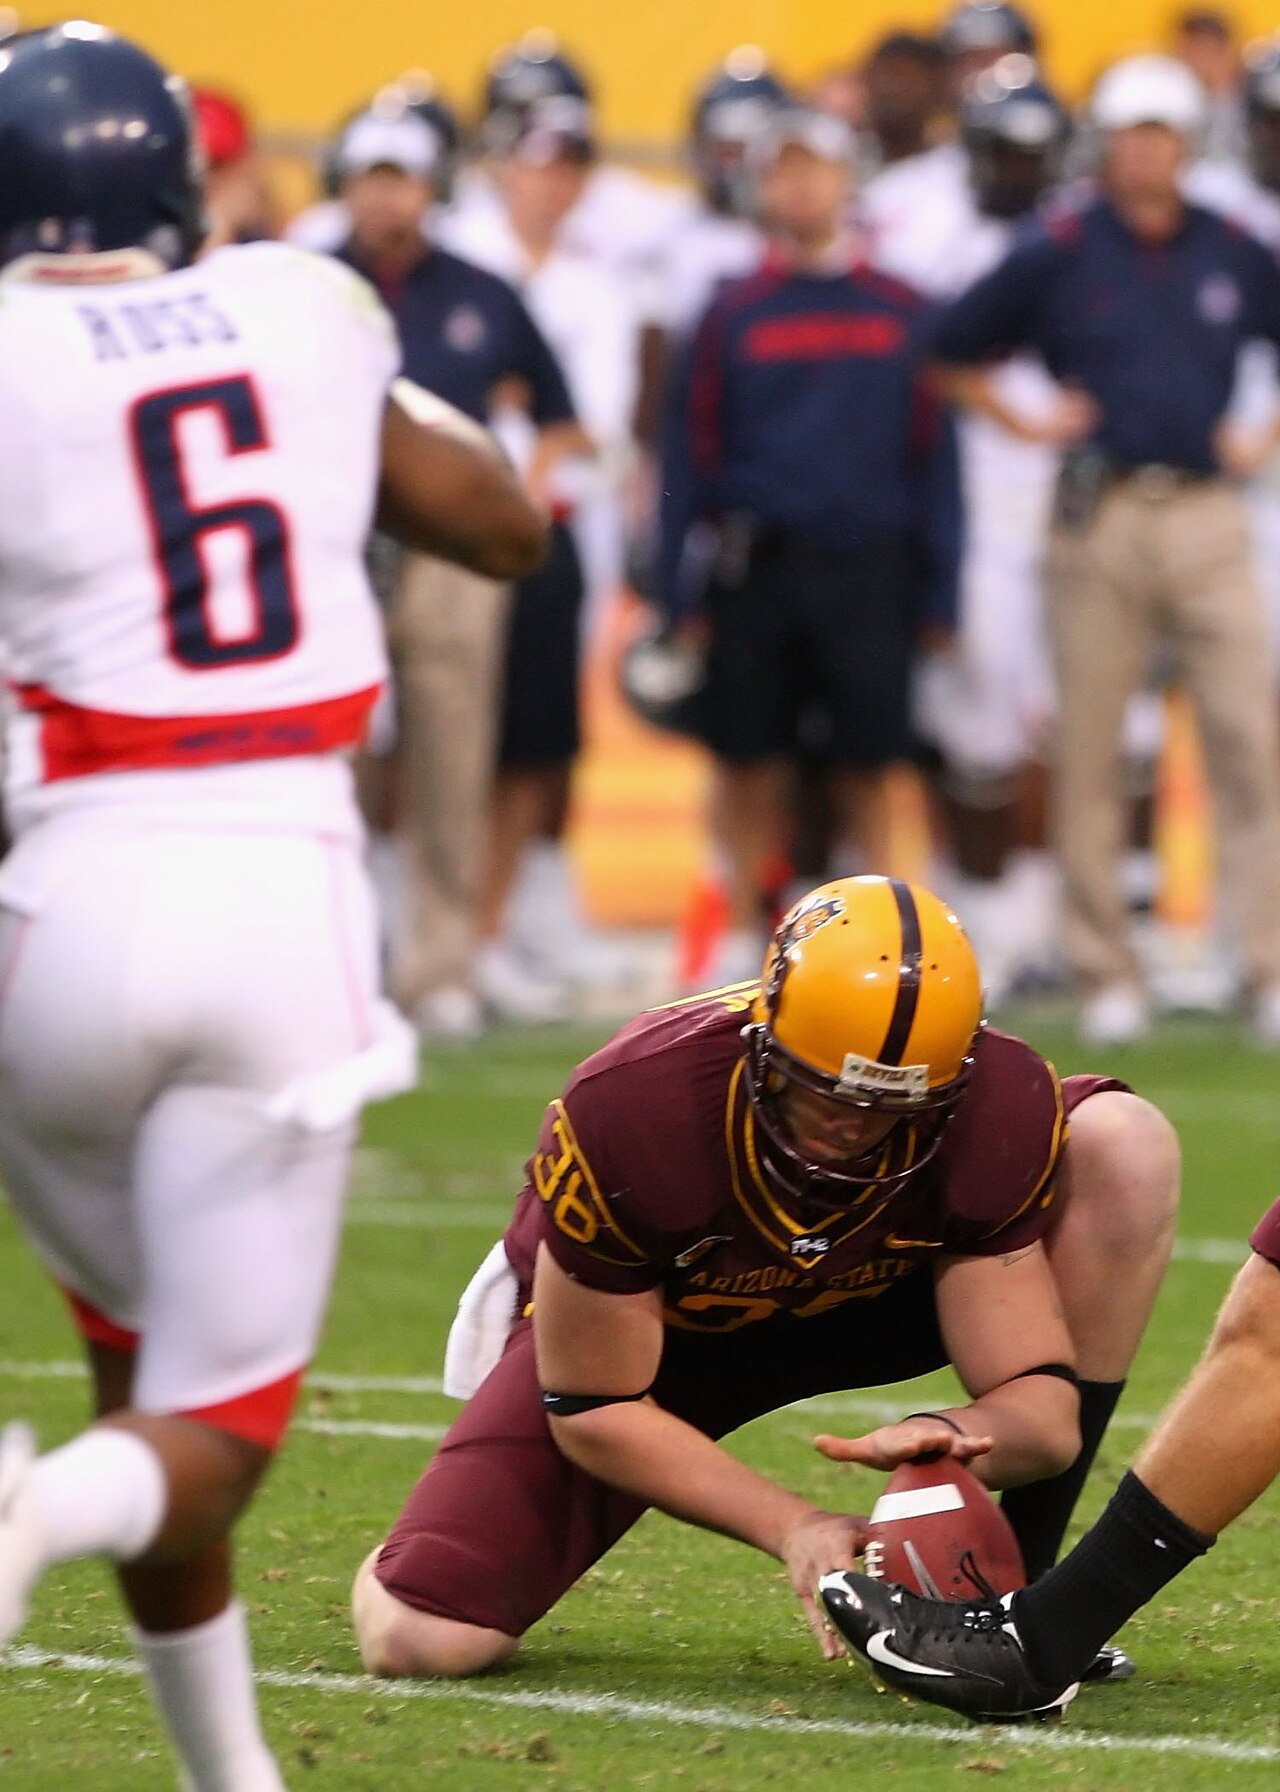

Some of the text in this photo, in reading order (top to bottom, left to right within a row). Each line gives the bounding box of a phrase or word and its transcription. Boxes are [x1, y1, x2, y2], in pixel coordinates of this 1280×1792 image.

[76, 294, 240, 360] ROSS
[127, 371, 302, 674] 6
[688, 1257, 912, 1293] ARIZONA STATE
